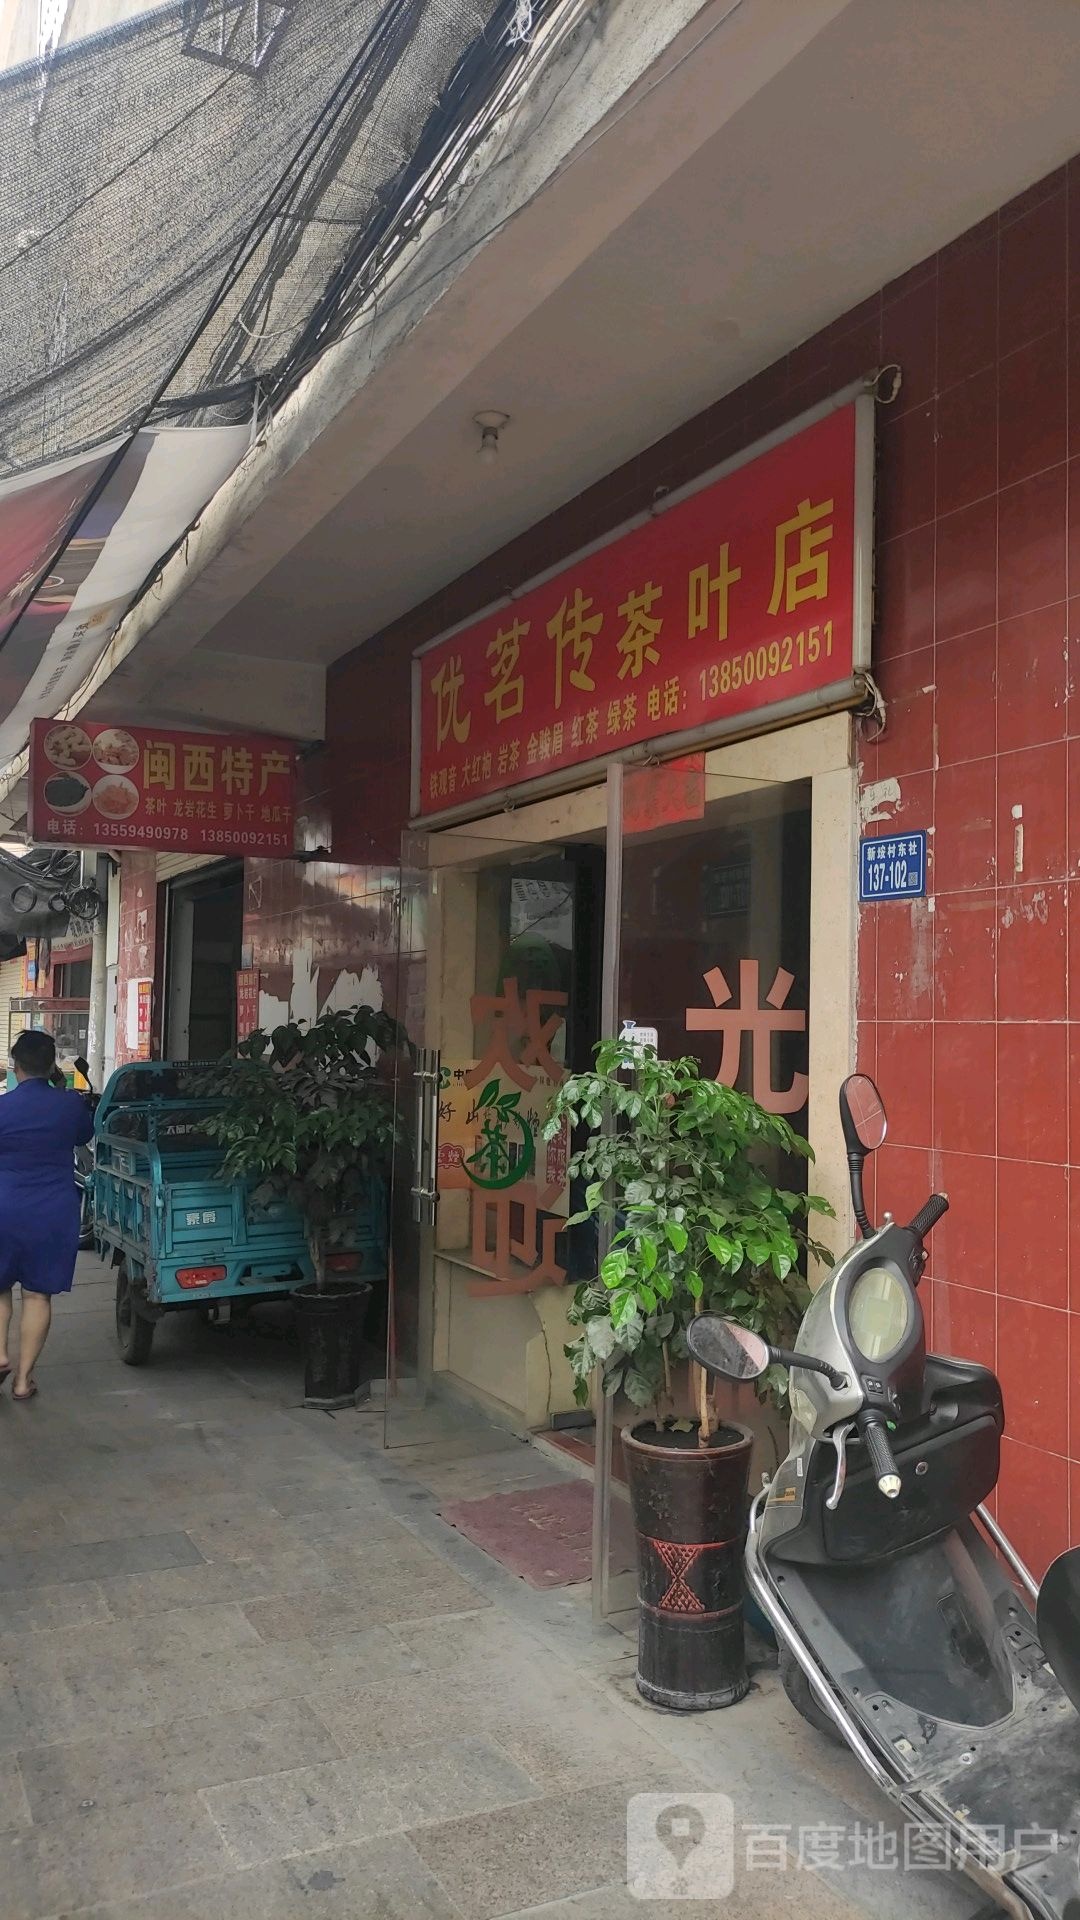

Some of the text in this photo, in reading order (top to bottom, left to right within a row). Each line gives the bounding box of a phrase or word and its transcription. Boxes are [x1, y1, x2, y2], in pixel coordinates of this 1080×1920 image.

[430, 497, 834, 752] 优茗传茶叶店
[430, 765, 457, 799] 铁观音
[461, 750, 492, 788] 大红袍
[497, 739, 520, 775] 岩茶
[526, 721, 564, 765] 金骏眉
[571, 707, 599, 748] 红茶
[607, 692, 638, 736] 绿茶
[699, 619, 833, 701] 13850092151
[143, 740, 291, 797] 闽西特产
[145, 797, 167, 816] 茶叶
[173, 799, 217, 820] 龙岩花生
[260, 805, 292, 824] 地瓜干
[93, 822, 188, 841] 13559490978
[199, 828, 288, 846] 13850092151
[867, 840, 917, 861] 新垵村东社
[868, 860, 907, 891] 137-102
[685, 959, 809, 1114] 光
